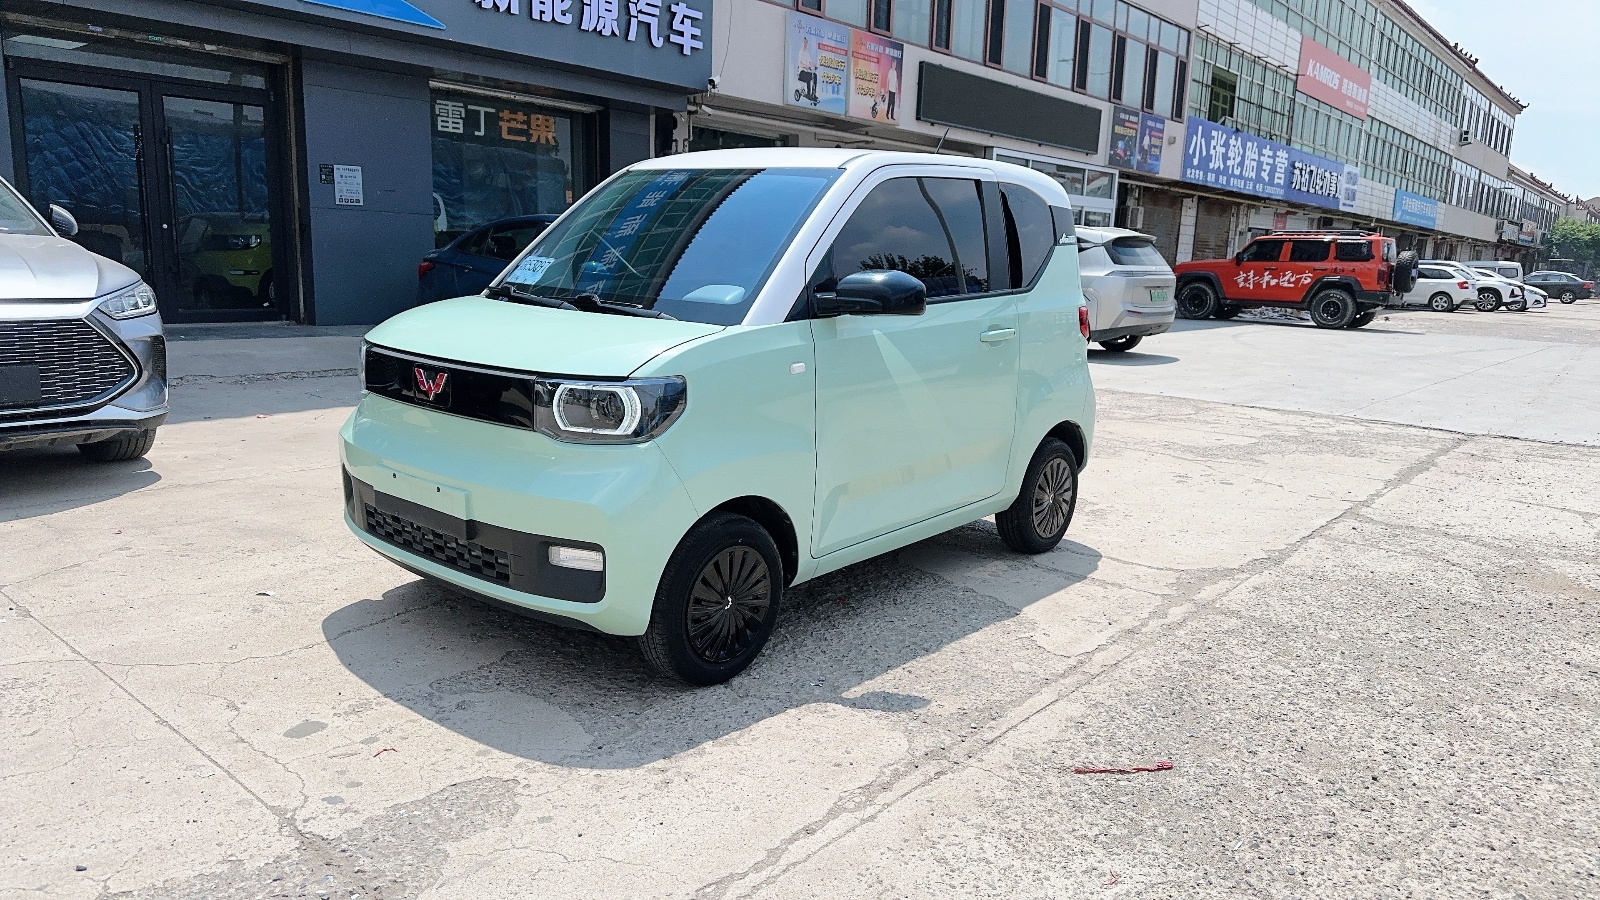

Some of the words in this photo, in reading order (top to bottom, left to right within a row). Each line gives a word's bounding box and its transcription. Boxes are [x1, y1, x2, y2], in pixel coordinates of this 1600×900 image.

[435, 99, 556, 145] 雷丁芒果
[1188, 125, 1288, 186] 小张轮胎专营
